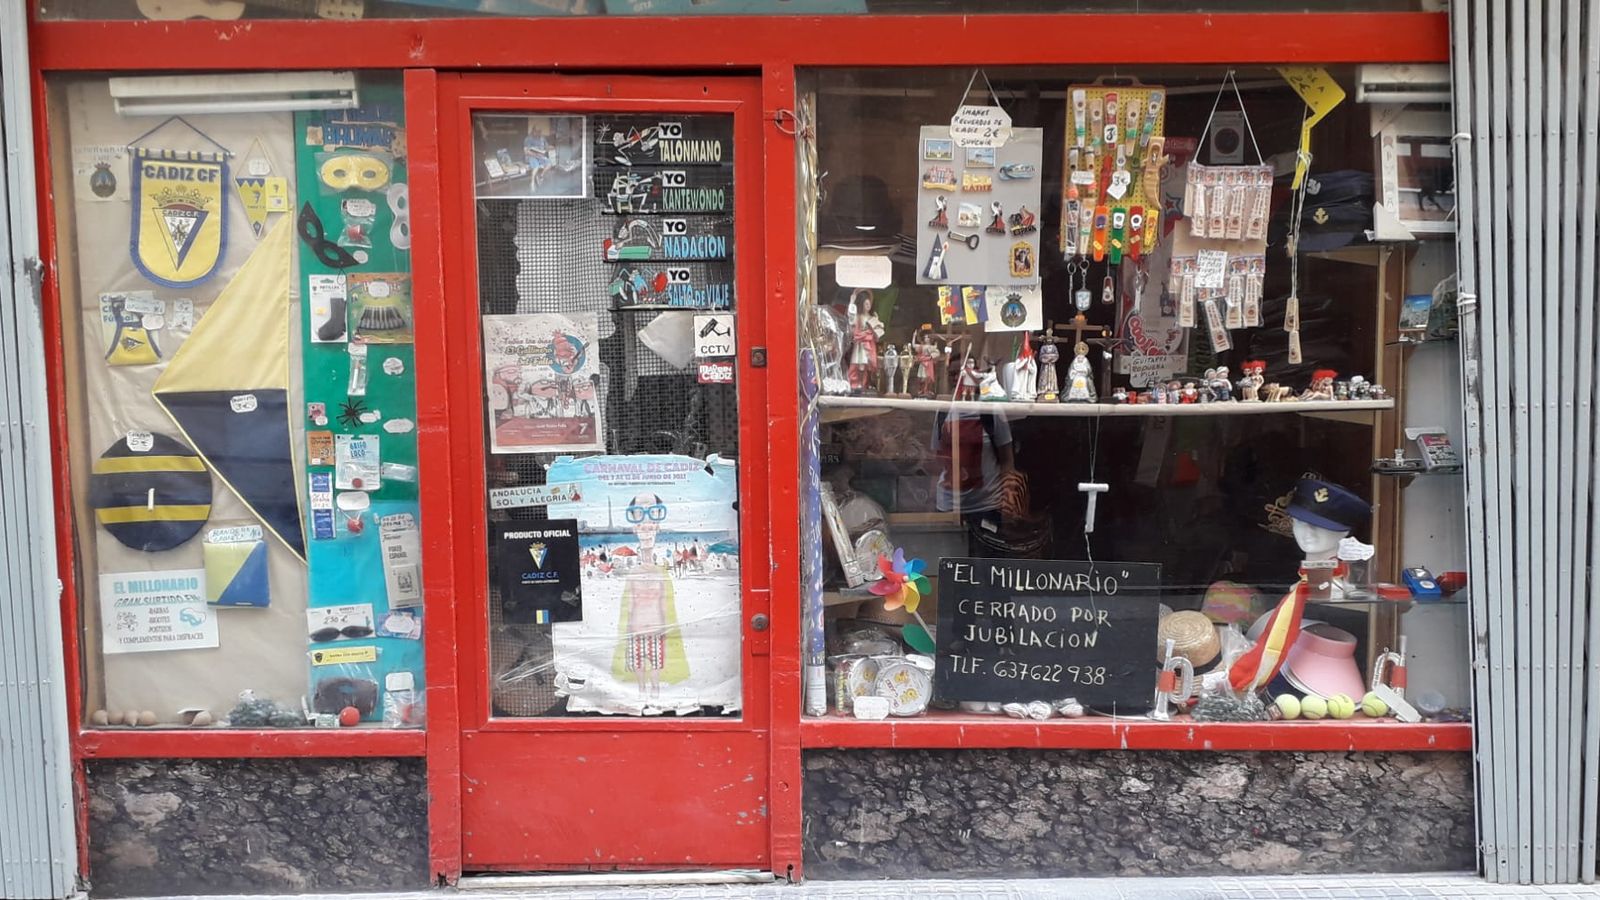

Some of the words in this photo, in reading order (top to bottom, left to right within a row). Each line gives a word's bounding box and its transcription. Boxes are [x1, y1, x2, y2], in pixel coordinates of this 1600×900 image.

[660, 124, 682, 136] YO
[659, 139, 722, 162] TALONMANO
[144, 165, 195, 181] CADIZ
[196, 168, 220, 182] CF
[664, 173, 686, 185] YO
[662, 188, 725, 210] KANTEWONDO
[665, 221, 687, 233] YO
[663, 235, 727, 258] NADACION
[669, 269, 690, 281] YO
[694, 291, 706, 306] DE
[706, 283, 729, 306] VIAJE
[701, 345, 730, 354] CCTV
[579, 423, 589, 435] 7
[584, 463, 644, 475] CARNAVAL
[647, 463, 660, 473] DE
[662, 462, 700, 473] CADIZ
[491, 488, 542, 498] ANDALUCIA
[496, 498, 515, 507] SOL
[529, 493, 568, 505] ALEGRIA
[503, 530, 542, 540] PRODUCTO
[543, 529, 572, 538] OFICIAL
[521, 571, 545, 580] CADIZ
[113, 581, 125, 594] EL
[127, 577, 199, 593] MILLONARIO
[958, 599, 1057, 623] CERRADO
[1071, 607, 1112, 628] POR
[949, 654, 987, 675] TLF.
